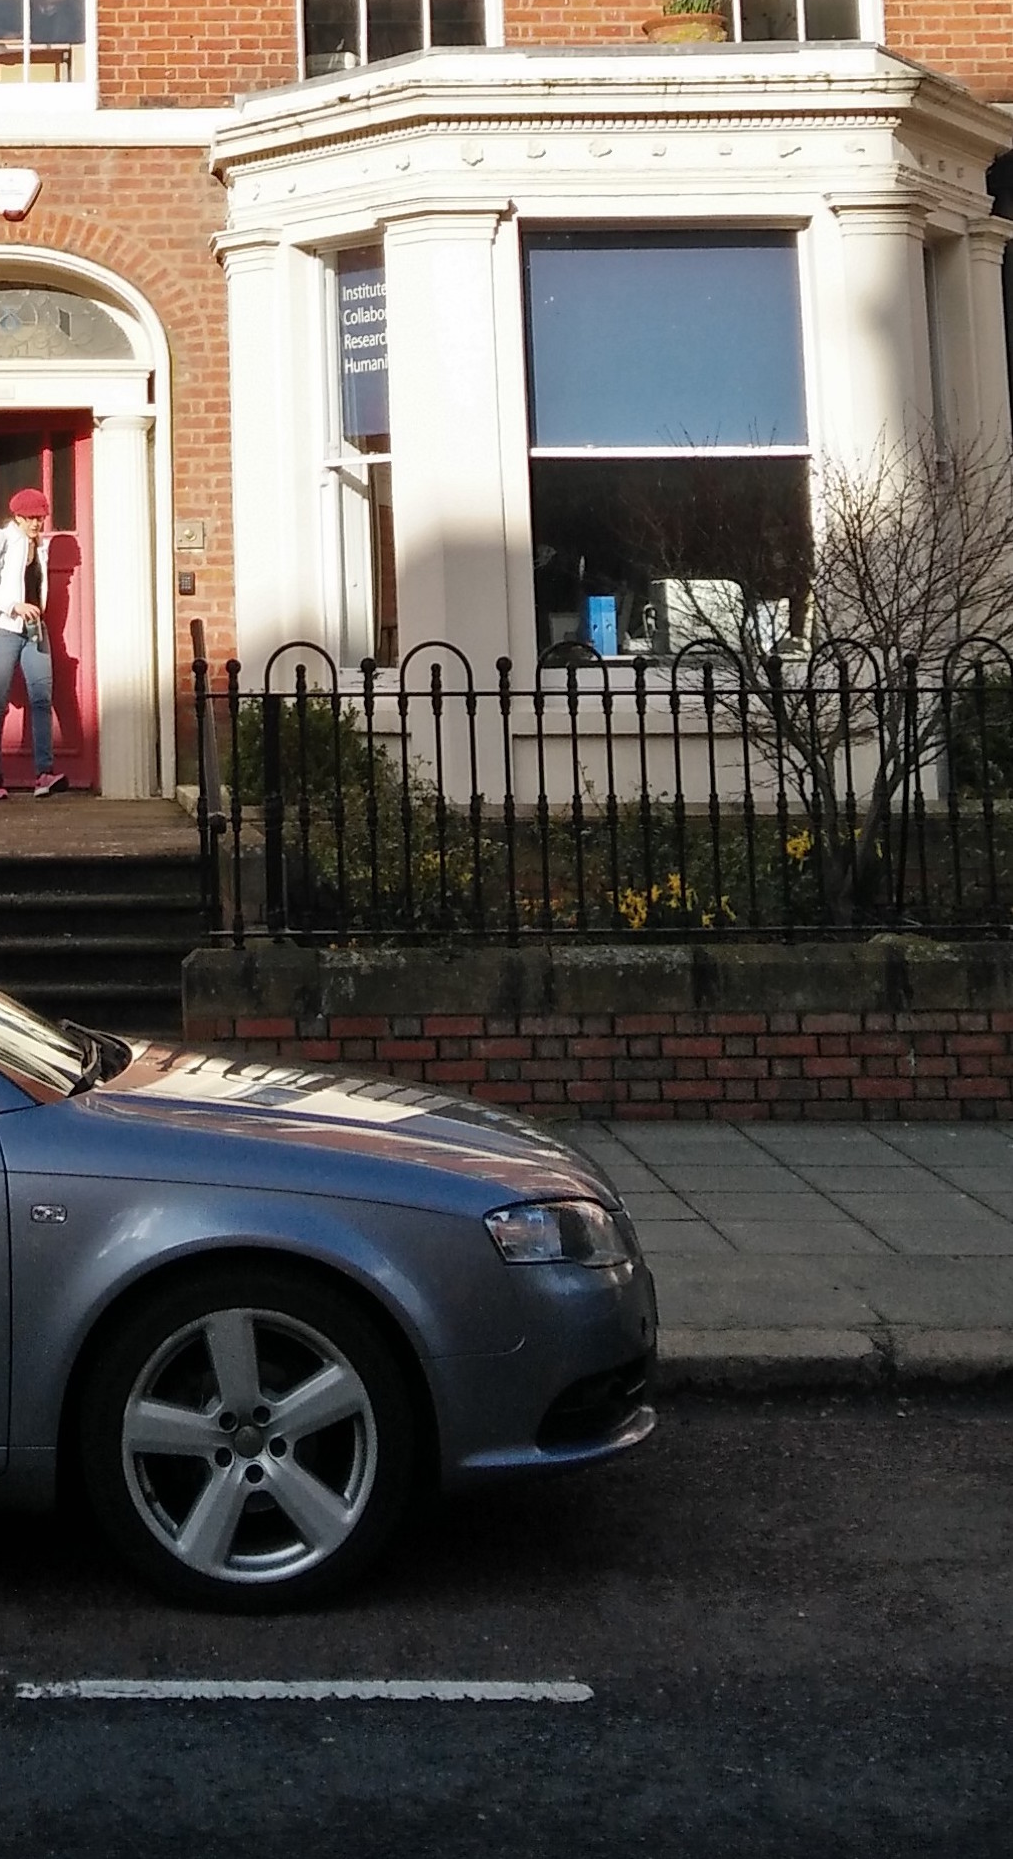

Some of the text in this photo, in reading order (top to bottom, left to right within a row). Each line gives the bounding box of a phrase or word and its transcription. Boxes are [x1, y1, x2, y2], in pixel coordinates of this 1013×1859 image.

[343, 283, 386, 301] Institute
[343, 305, 386, 325] Collabo
[344, 332, 386, 349] Researc
